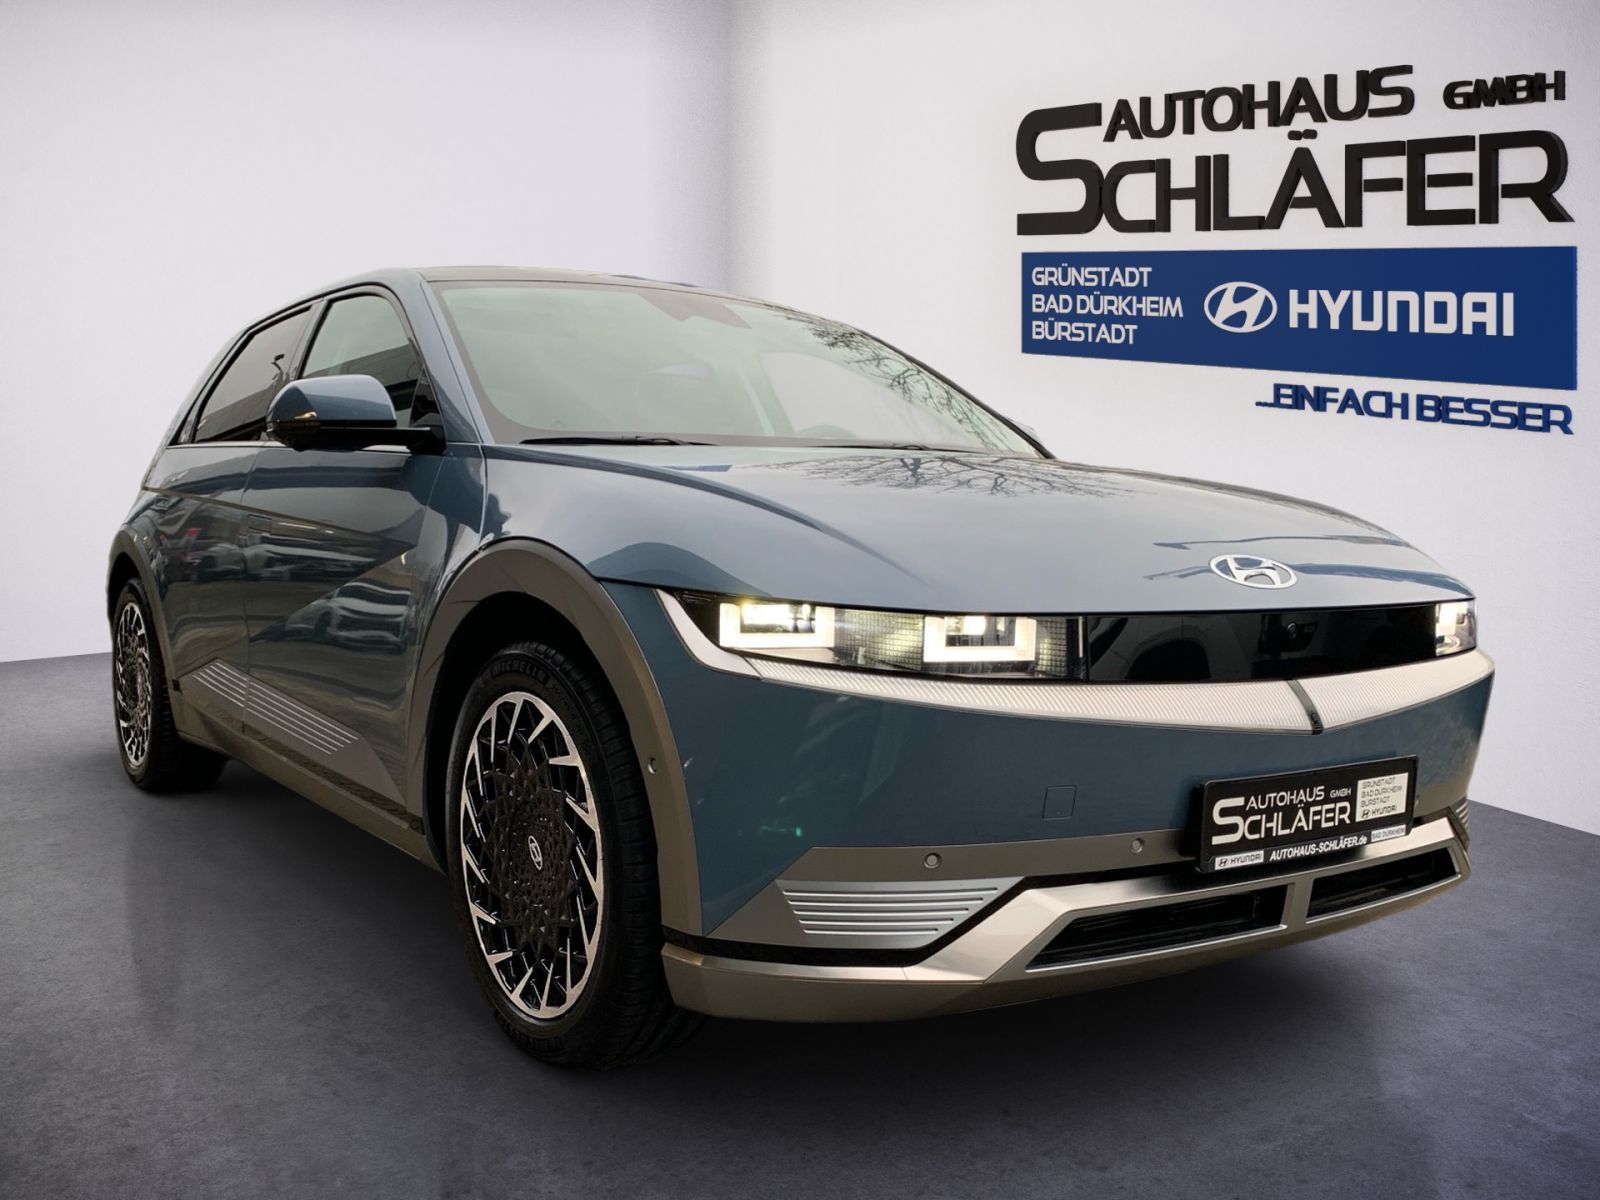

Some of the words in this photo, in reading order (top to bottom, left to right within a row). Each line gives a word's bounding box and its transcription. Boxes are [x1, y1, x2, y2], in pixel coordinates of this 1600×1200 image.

[1103, 65, 1415, 142] AUTOHAUS
[1443, 71, 1565, 109] GMBH
[1016, 103, 1574, 235] SCHLÄFER
[1031, 264, 1152, 288] GRÜNSTADT
[1031, 293, 1073, 314] BAD
[1076, 292, 1184, 318] DÜRKHEIM
[1289, 289, 1514, 337] HYUNDAI
[1031, 318, 1138, 345] BÜRSTADT
[1416, 394, 1574, 435] BESSER
[1246, 786, 1325, 811] AUTOHAUS
[1211, 797, 1351, 846] SCHLÄFER
[1230, 853, 1262, 865] HYUNDAI
[1269, 835, 1368, 862] AUTOHAUS-SCHLÄFER.de
